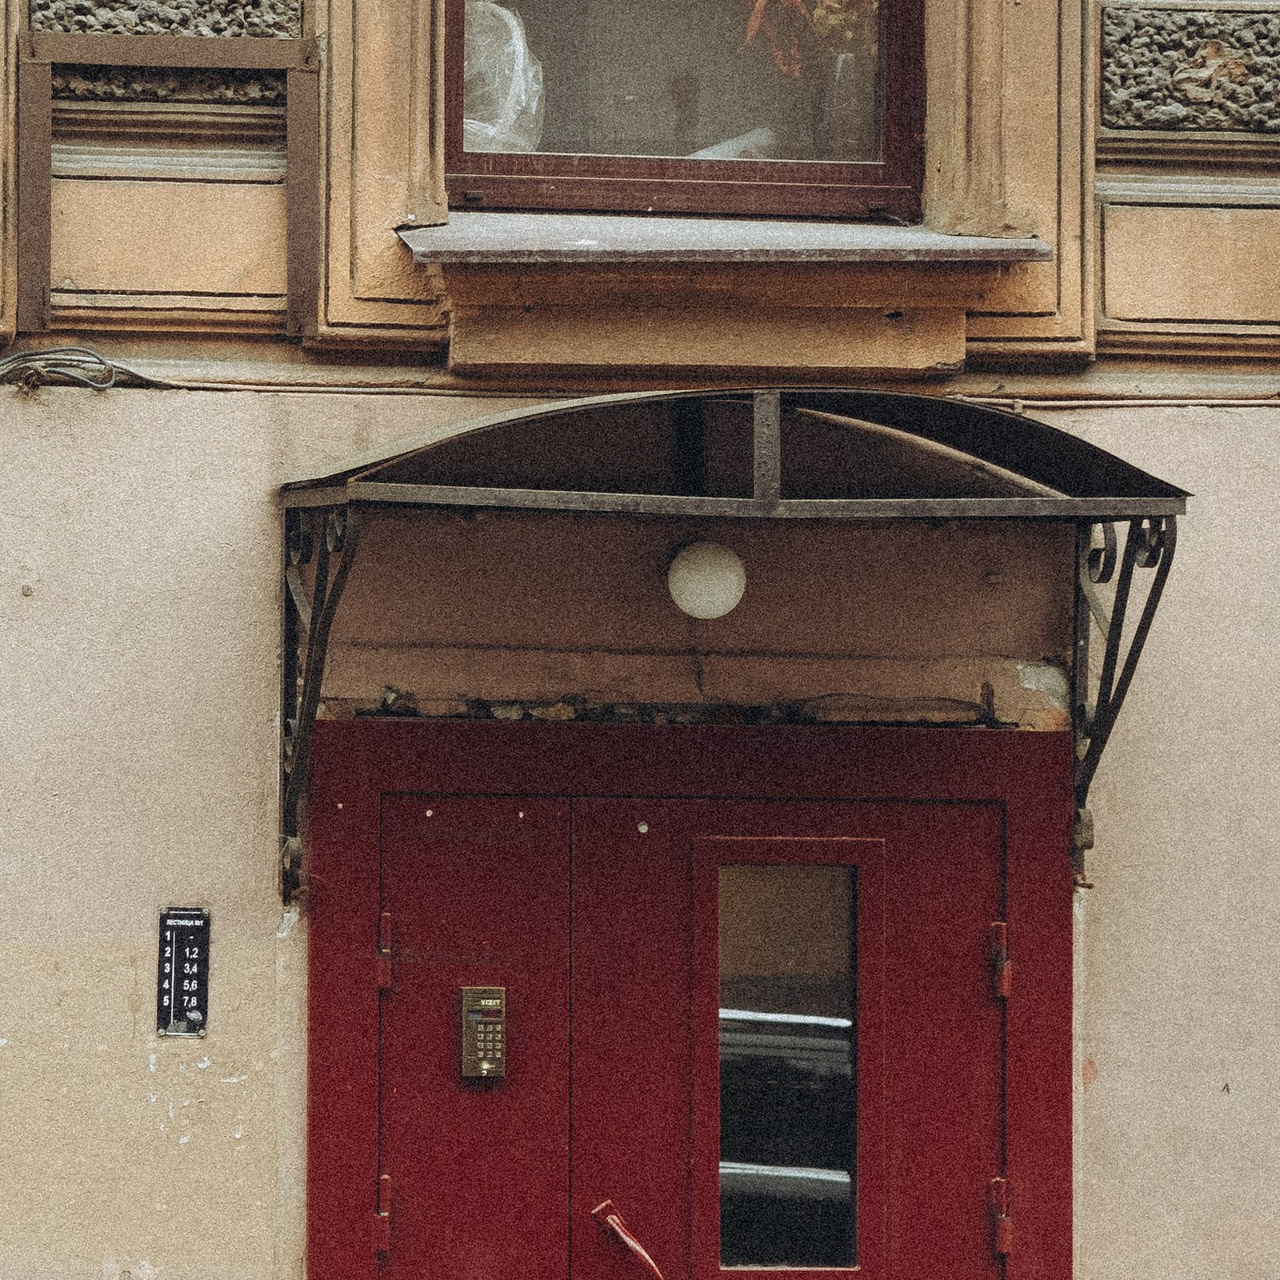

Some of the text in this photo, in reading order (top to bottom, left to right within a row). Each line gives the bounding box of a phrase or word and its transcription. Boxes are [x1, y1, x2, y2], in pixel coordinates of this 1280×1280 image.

[165, 930, 171, 941] 1
[164, 946, 199, 959] 2 1,2
[164, 963, 198, 975] 3 3,4
[163, 979, 198, 991] 4 5,6
[163, 995, 197, 1008] 5 7,8
